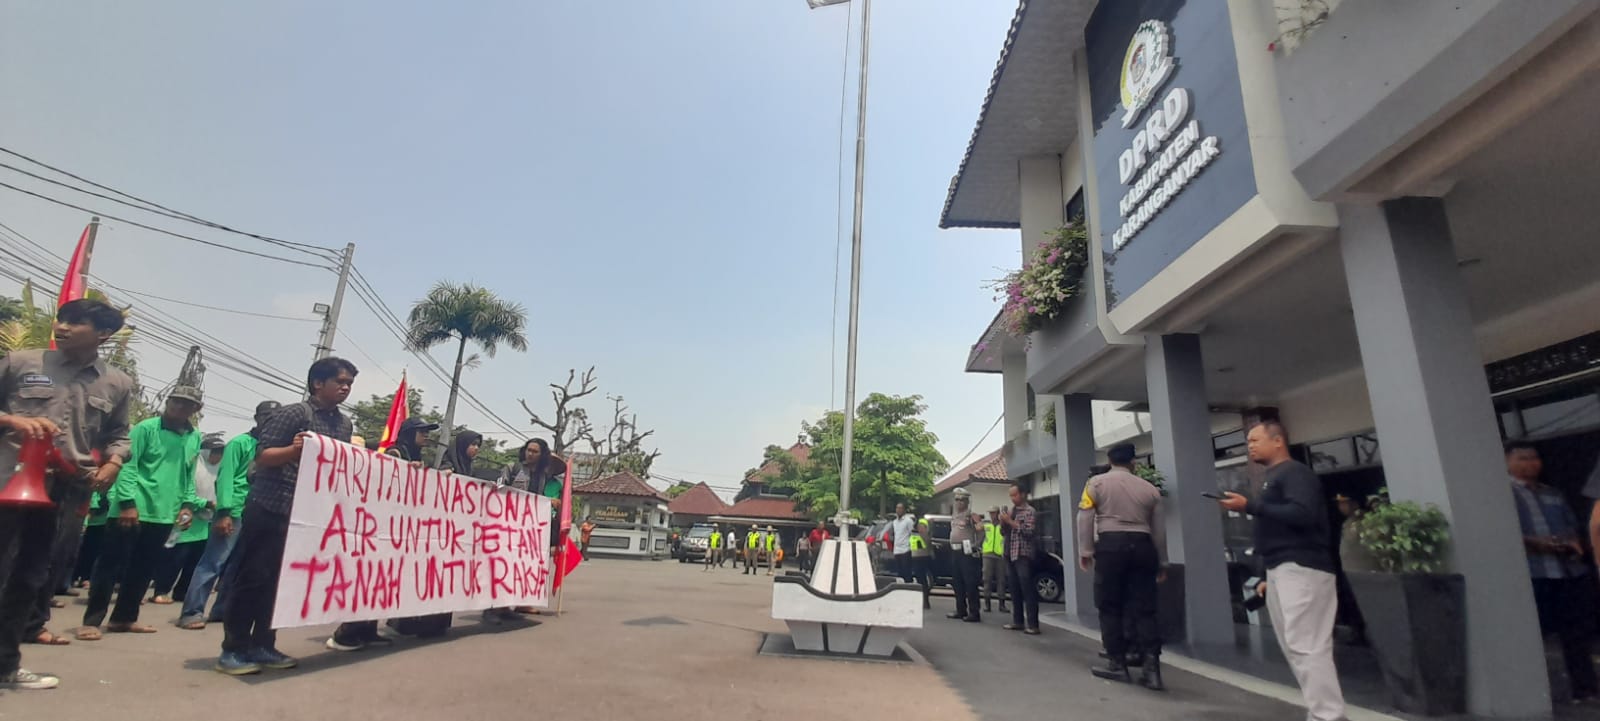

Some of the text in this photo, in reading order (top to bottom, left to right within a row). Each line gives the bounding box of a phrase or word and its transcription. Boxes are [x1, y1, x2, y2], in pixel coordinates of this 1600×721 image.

[1119, 87, 1188, 184] DPRD
[1119, 120, 1199, 217] KABUPATEN
[1111, 135, 1219, 250] KARANGANYAR
[314, 433, 549, 526] HARI TANI NASIONAL
[320, 503, 545, 565] AIR UNTUK PETANI
[290, 554, 405, 619] TANAH
[415, 555, 482, 600] UNTUK
